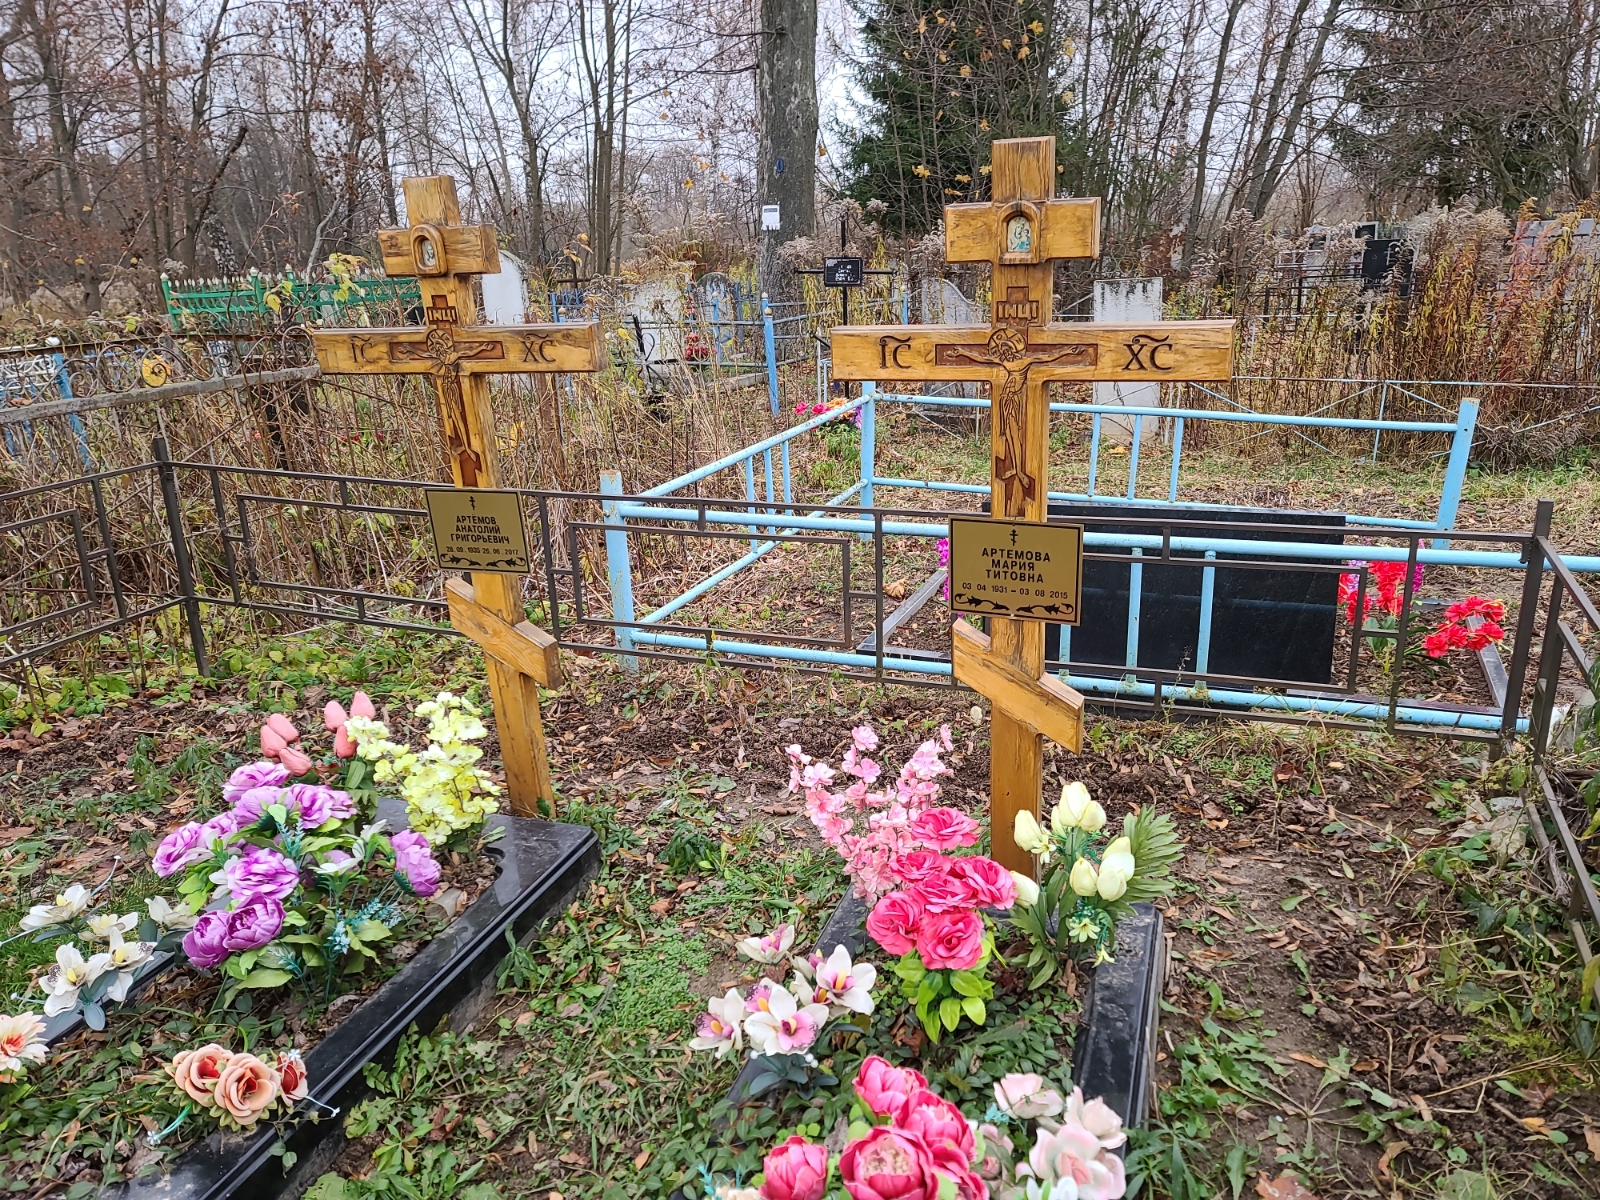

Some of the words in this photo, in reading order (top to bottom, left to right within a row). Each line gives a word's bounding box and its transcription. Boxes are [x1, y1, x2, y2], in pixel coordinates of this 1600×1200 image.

[455, 524, 501, 535] АНАТОЛИЙ
[450, 534, 510, 544] ГРИГОРЬЕВИЧ
[981, 548, 1051, 562] АРТЕМОВА
[991, 559, 1035, 571] МАРИЯ
[985, 569, 1044, 583] ТИТОВНА
[991, 585, 1007, 594] 1931
[1019, 588, 1030, 596] 03
[1049, 591, 1068, 599] 2015
